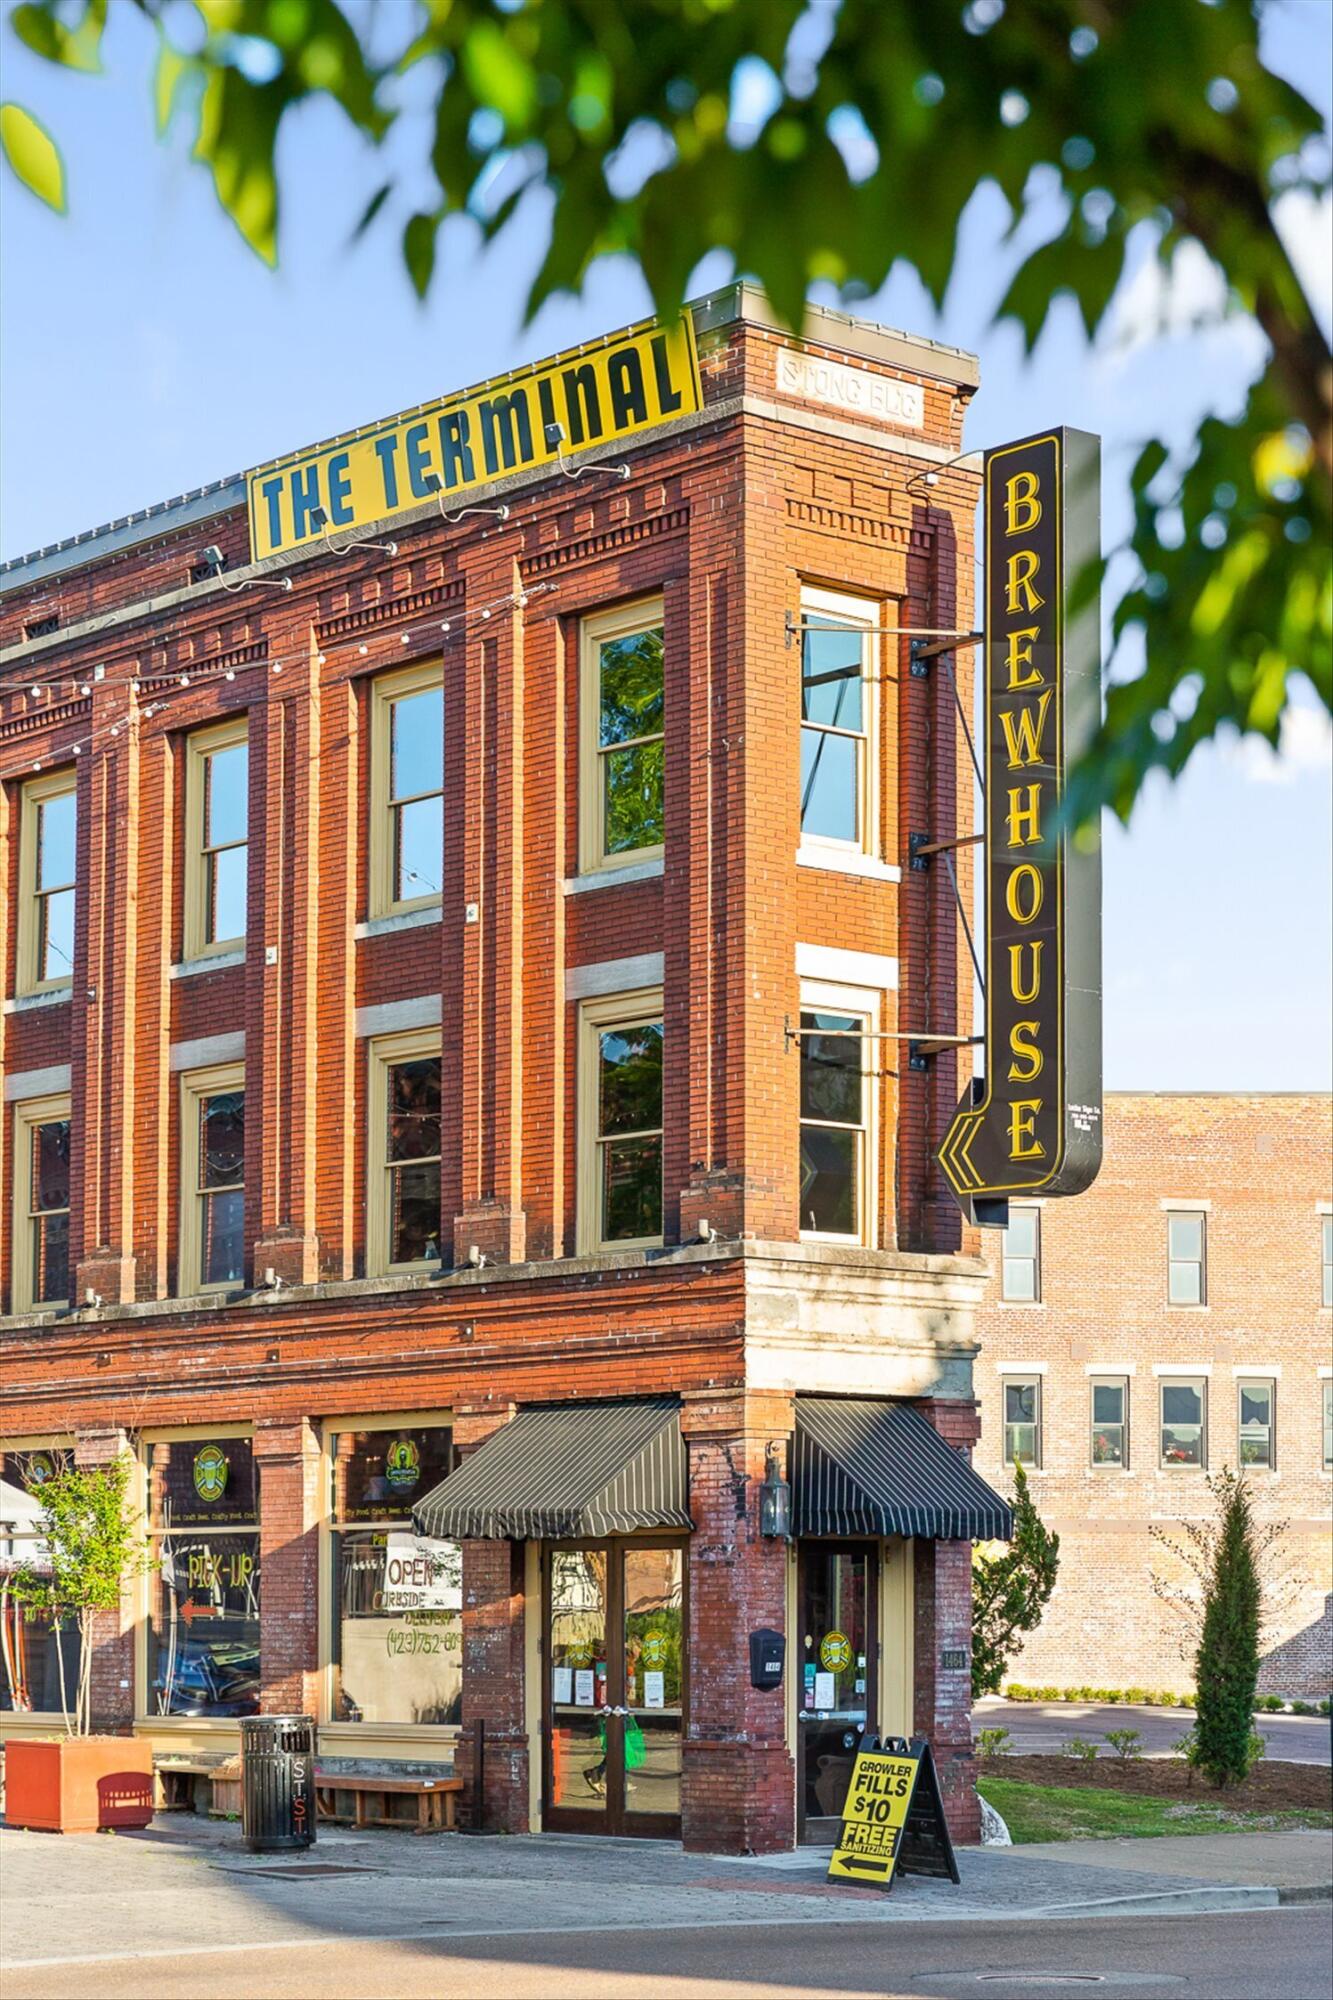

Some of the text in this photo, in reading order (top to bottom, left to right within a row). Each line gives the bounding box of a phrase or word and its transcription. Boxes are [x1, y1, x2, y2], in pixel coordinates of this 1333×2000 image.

[262, 334, 682, 549] THE TERMINAL
[998, 471, 1054, 1161] BREWHOUSE
[189, 1552, 253, 1589] PICK-UP
[388, 1558, 433, 1587] OPEN
[859, 1760, 912, 1777] GROWLER
[854, 1774, 909, 1797] FILLS
[853, 1795, 891, 1823] $10
[842, 1822, 898, 1846] FREE
[840, 1841, 892, 1856] SANITIZING
